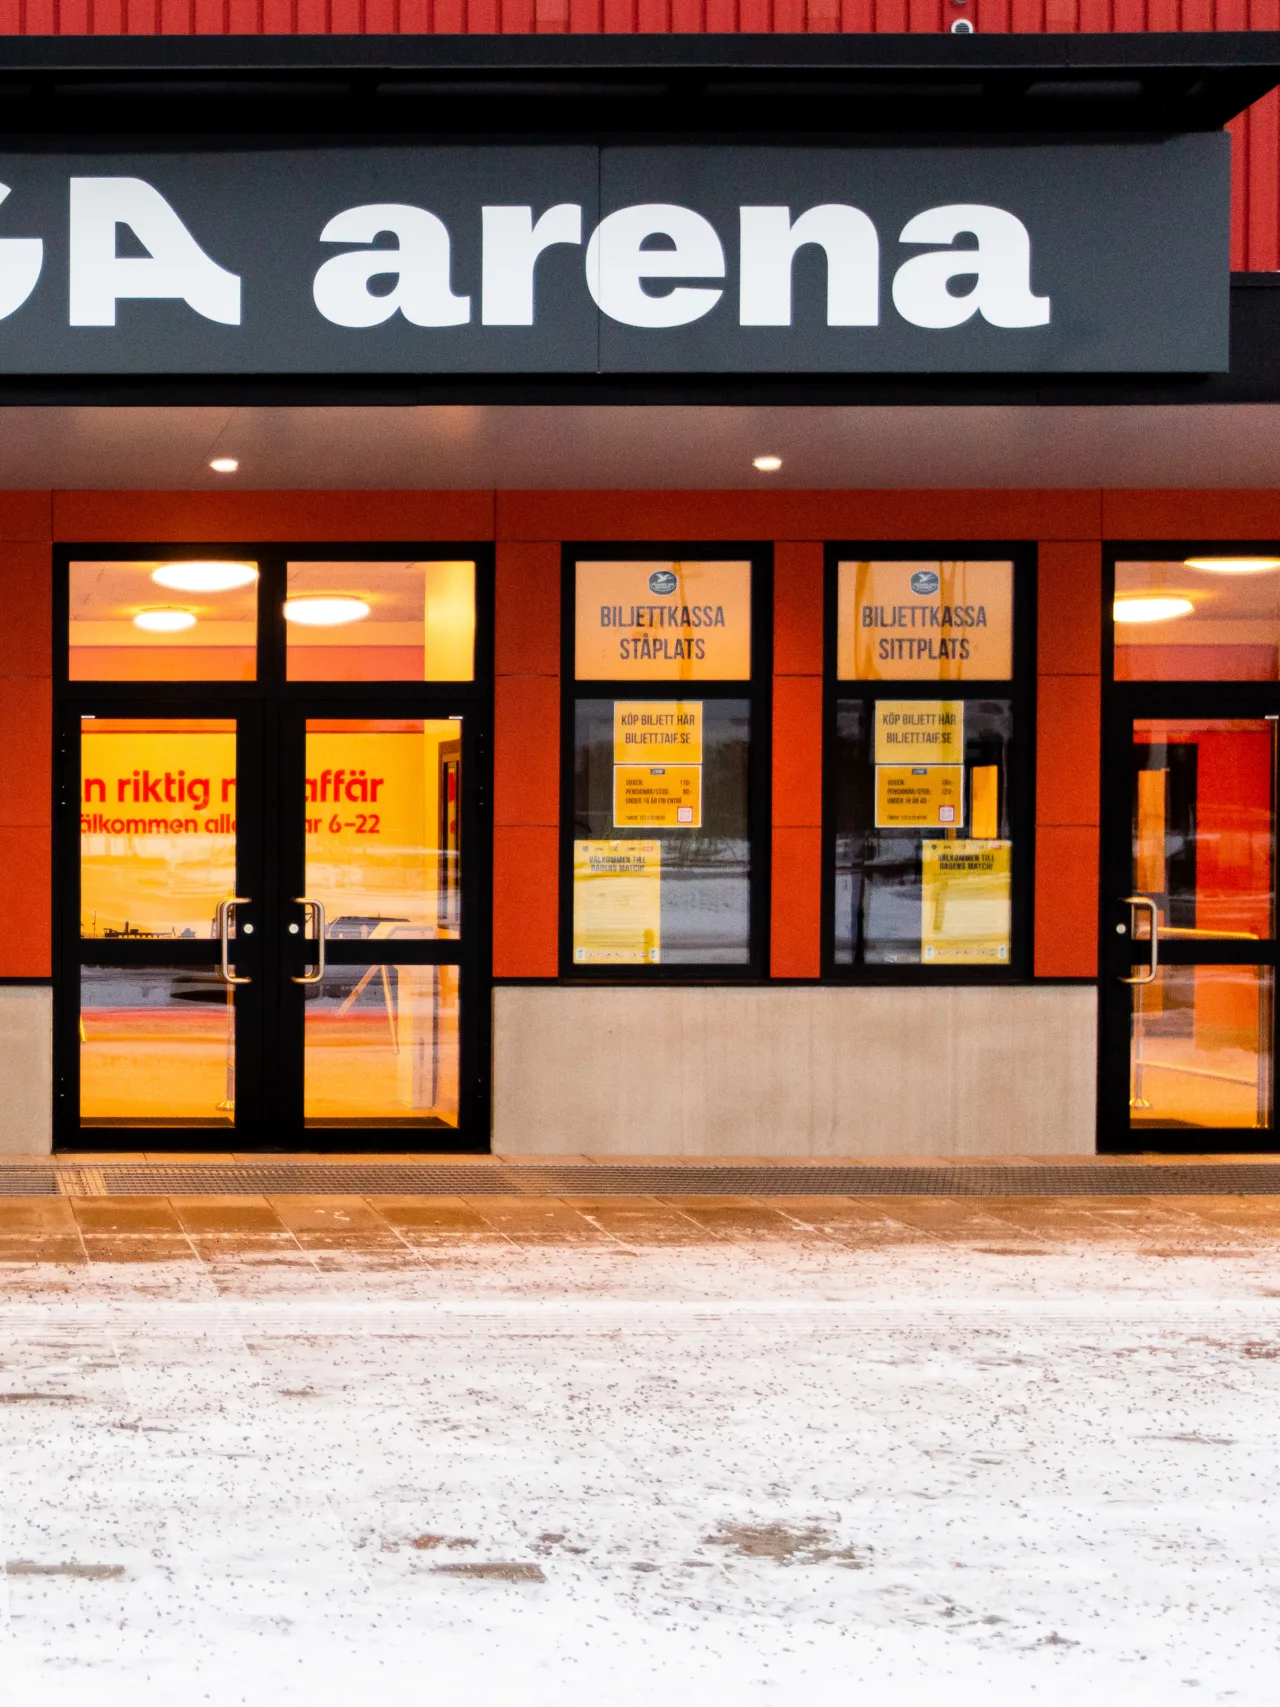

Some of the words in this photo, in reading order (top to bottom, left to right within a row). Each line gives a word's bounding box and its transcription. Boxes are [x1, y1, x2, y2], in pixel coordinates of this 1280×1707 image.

[313, 203, 1050, 328] arena
[600, 605, 725, 627] BILJETTKASSA
[862, 605, 987, 627] BILJETTKASSA
[619, 633, 705, 660] STÅPLATS
[879, 638, 970, 660] SITTPLATS
[621, 712, 638, 725] KÖP
[641, 714, 674, 725] BILJETT
[677, 712, 695, 725] HÄR
[882, 711, 900, 725] KÖP
[902, 714, 936, 725] BILJETT
[938, 711, 956, 725] HÄR
[84, 778, 106, 802] n
[118, 770, 210, 811] riktig
[81, 813, 198, 834] älkommen
